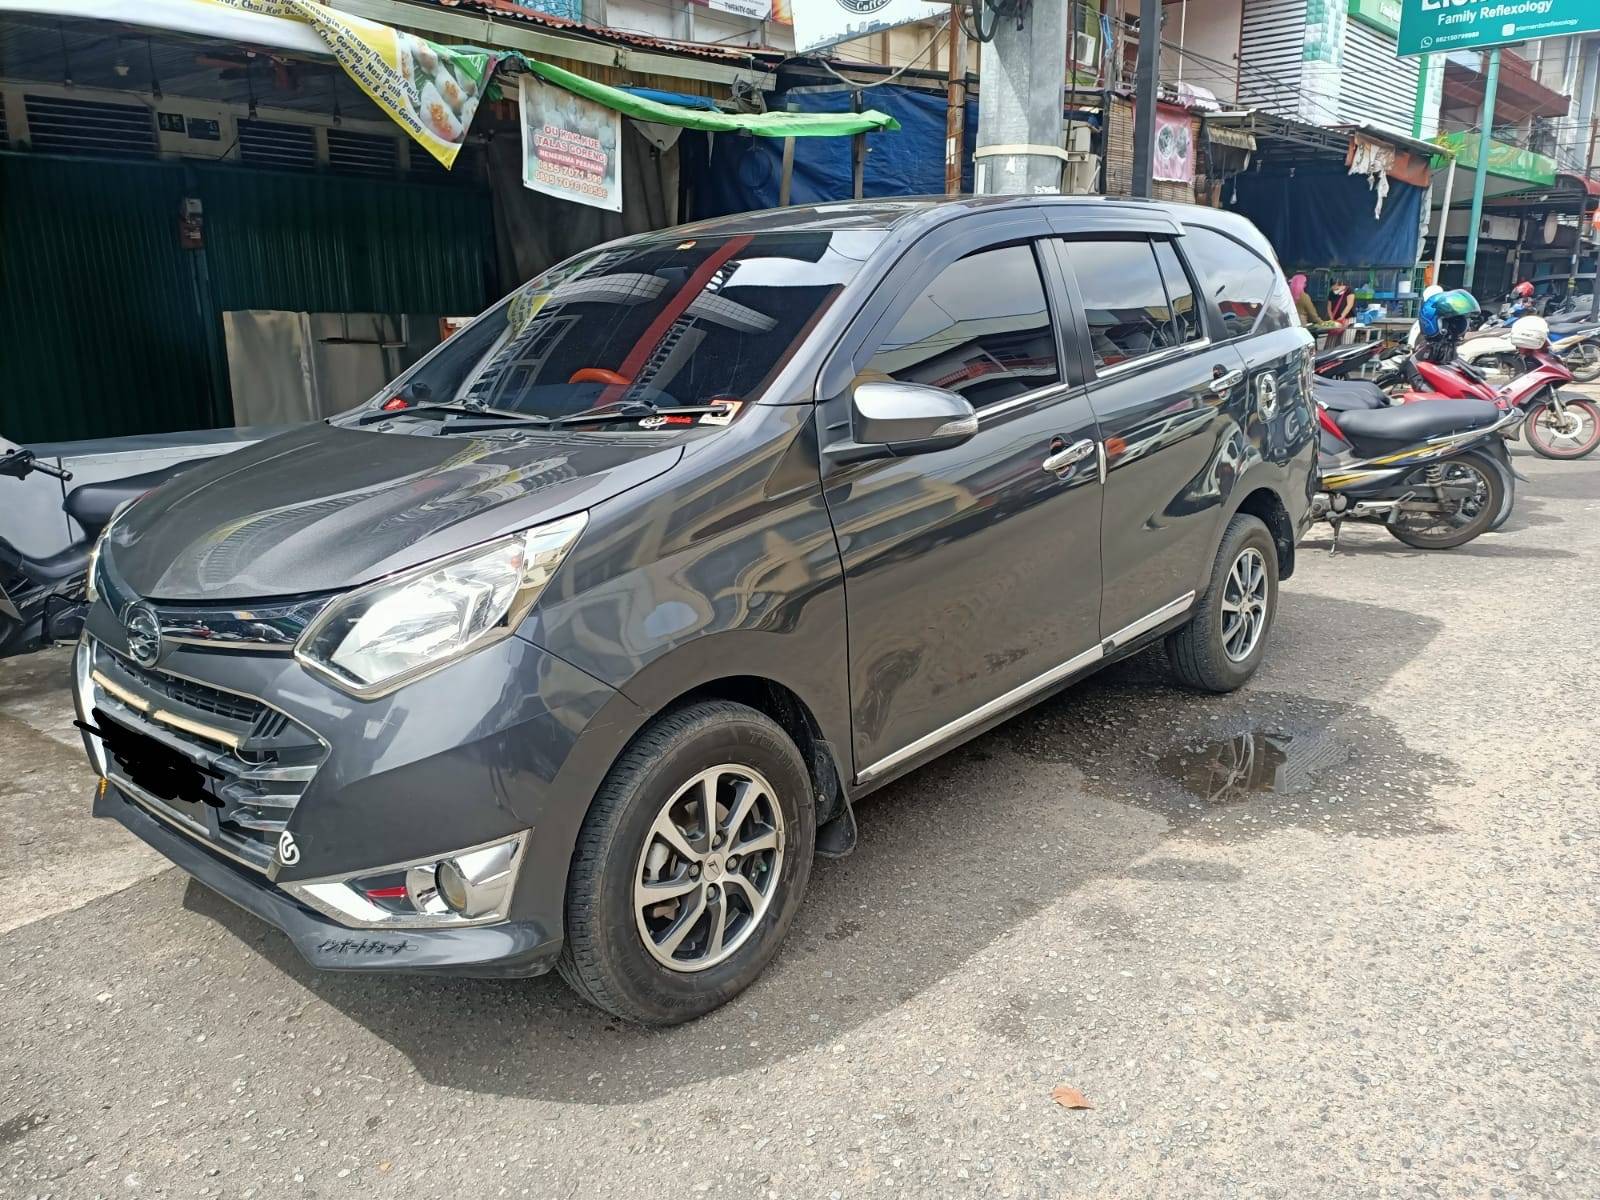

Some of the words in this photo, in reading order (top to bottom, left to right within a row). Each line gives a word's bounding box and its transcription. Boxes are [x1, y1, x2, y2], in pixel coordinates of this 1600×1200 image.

[1437, 11, 1477, 26] Family
[1480, 0, 1553, 20] Reflexology
[336, 35, 364, 65] Goreng,
[365, 62, 384, 81] Nasi
[384, 78, 402, 98] Putih
[350, 63, 373, 86] Kukus
[372, 84, 381, 93] &
[379, 90, 398, 109] Sosis
[398, 107, 423, 134] Goreng
